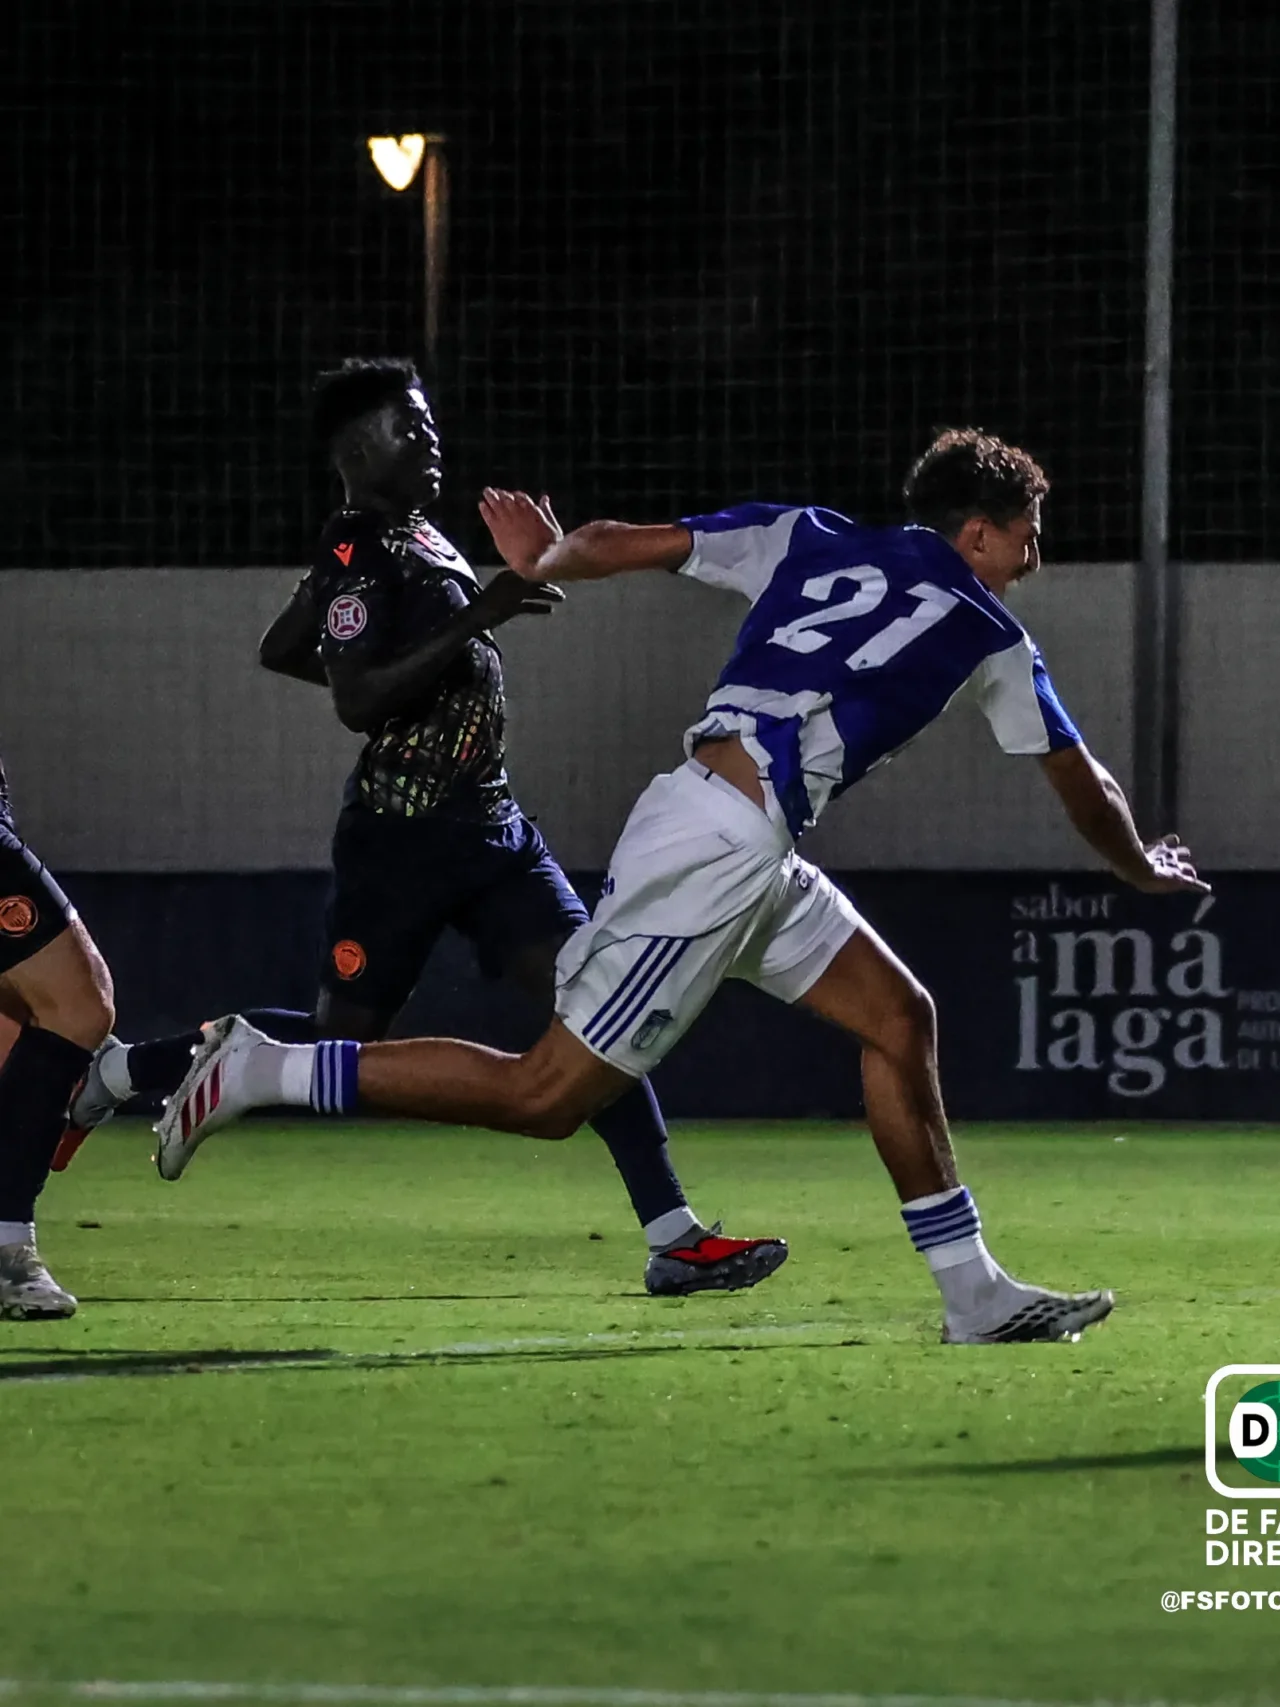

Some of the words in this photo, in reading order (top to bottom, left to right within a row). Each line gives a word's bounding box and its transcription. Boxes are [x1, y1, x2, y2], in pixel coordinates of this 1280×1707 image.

[766, 564, 960, 672] 21
[1010, 881, 1118, 920] sabor
[1049, 895, 1234, 998] má
[1013, 975, 1231, 1097] laga
[1237, 1048, 1260, 1070] DE
